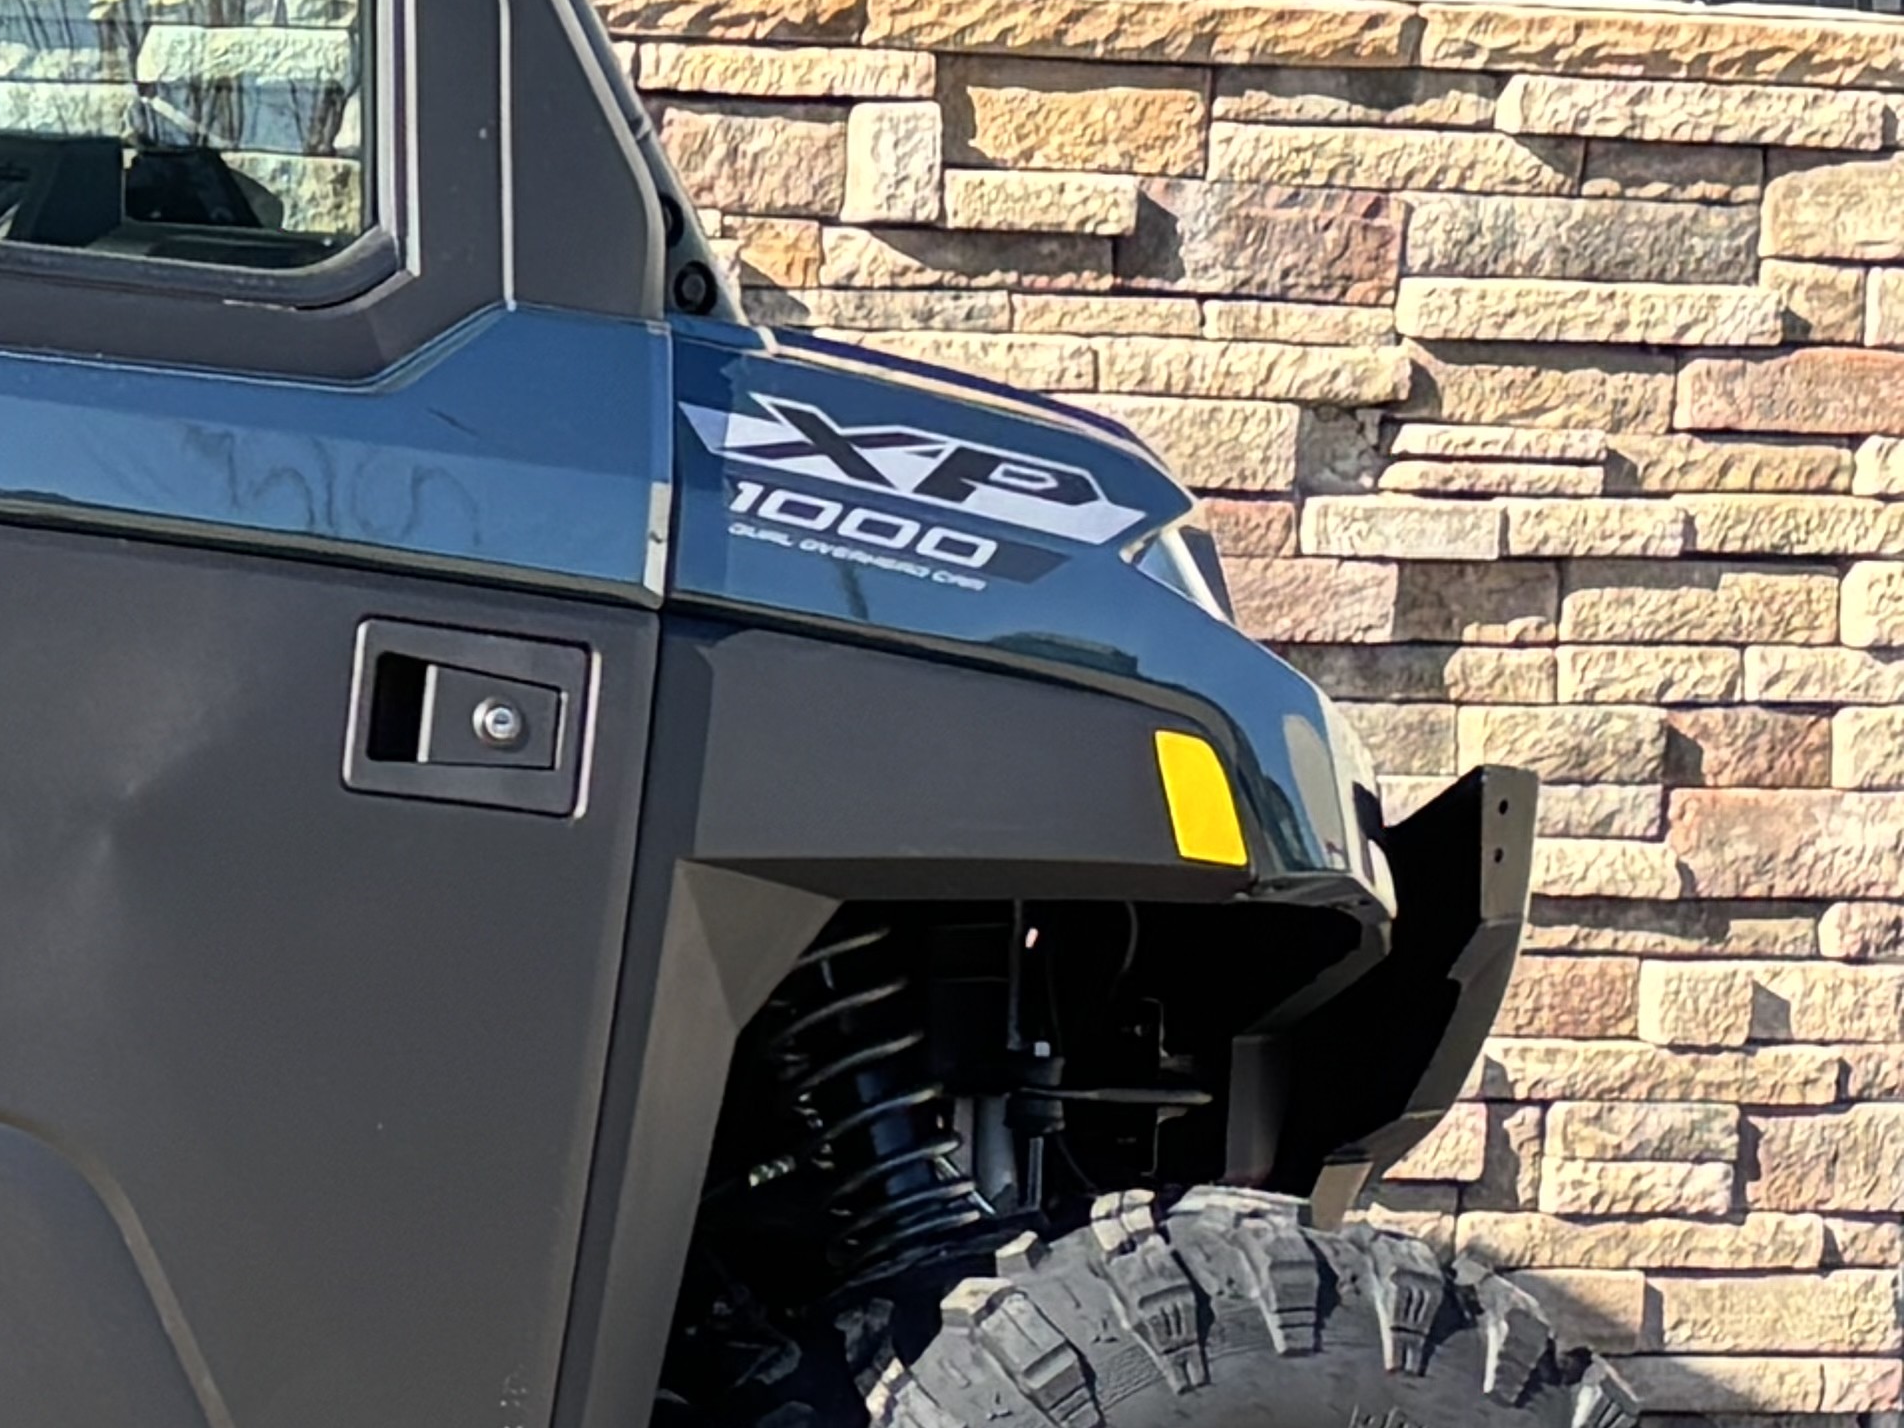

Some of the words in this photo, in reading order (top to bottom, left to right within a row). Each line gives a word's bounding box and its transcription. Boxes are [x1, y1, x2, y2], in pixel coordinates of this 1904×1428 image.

[724, 394, 1108, 508] XP
[727, 480, 1000, 569] 1000
[728, 521, 794, 548] DUAL
[798, 537, 930, 581] OVERHEAD
